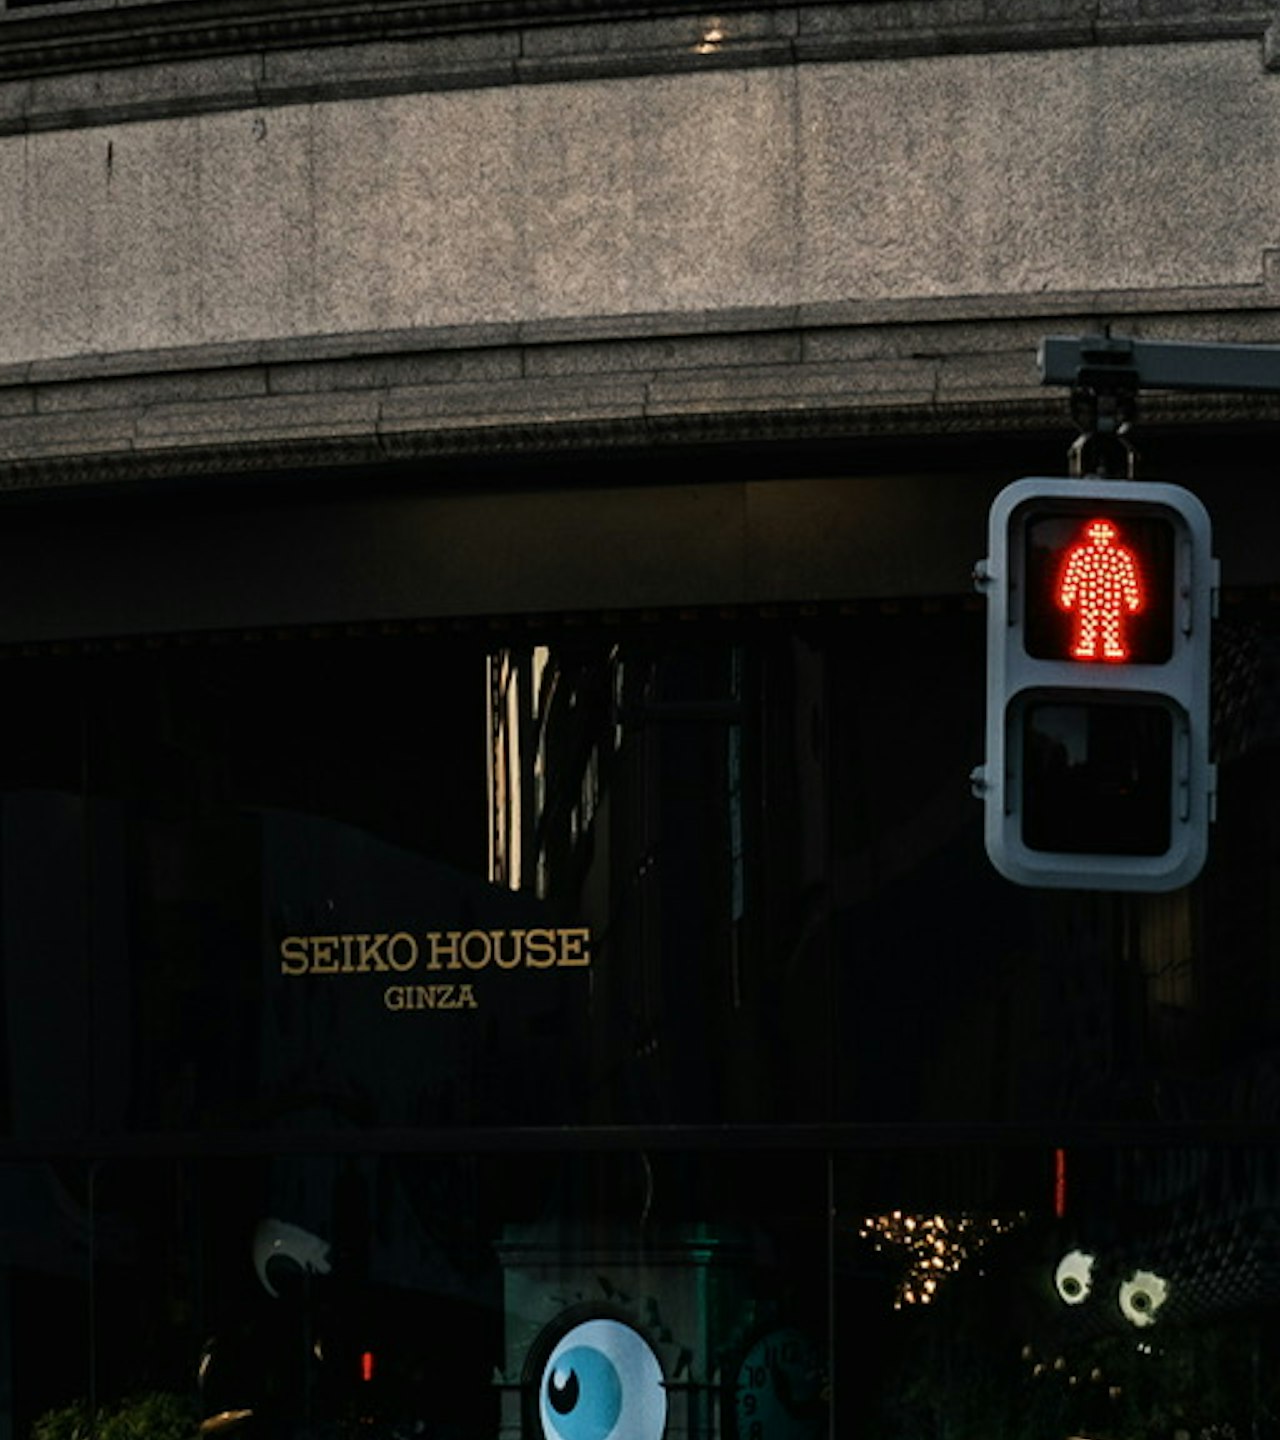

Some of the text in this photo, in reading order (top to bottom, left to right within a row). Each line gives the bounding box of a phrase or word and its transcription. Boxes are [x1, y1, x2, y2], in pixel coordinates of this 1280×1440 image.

[280, 926, 592, 976] SEIKO HOUSE
[383, 983, 479, 1012] GINZA
